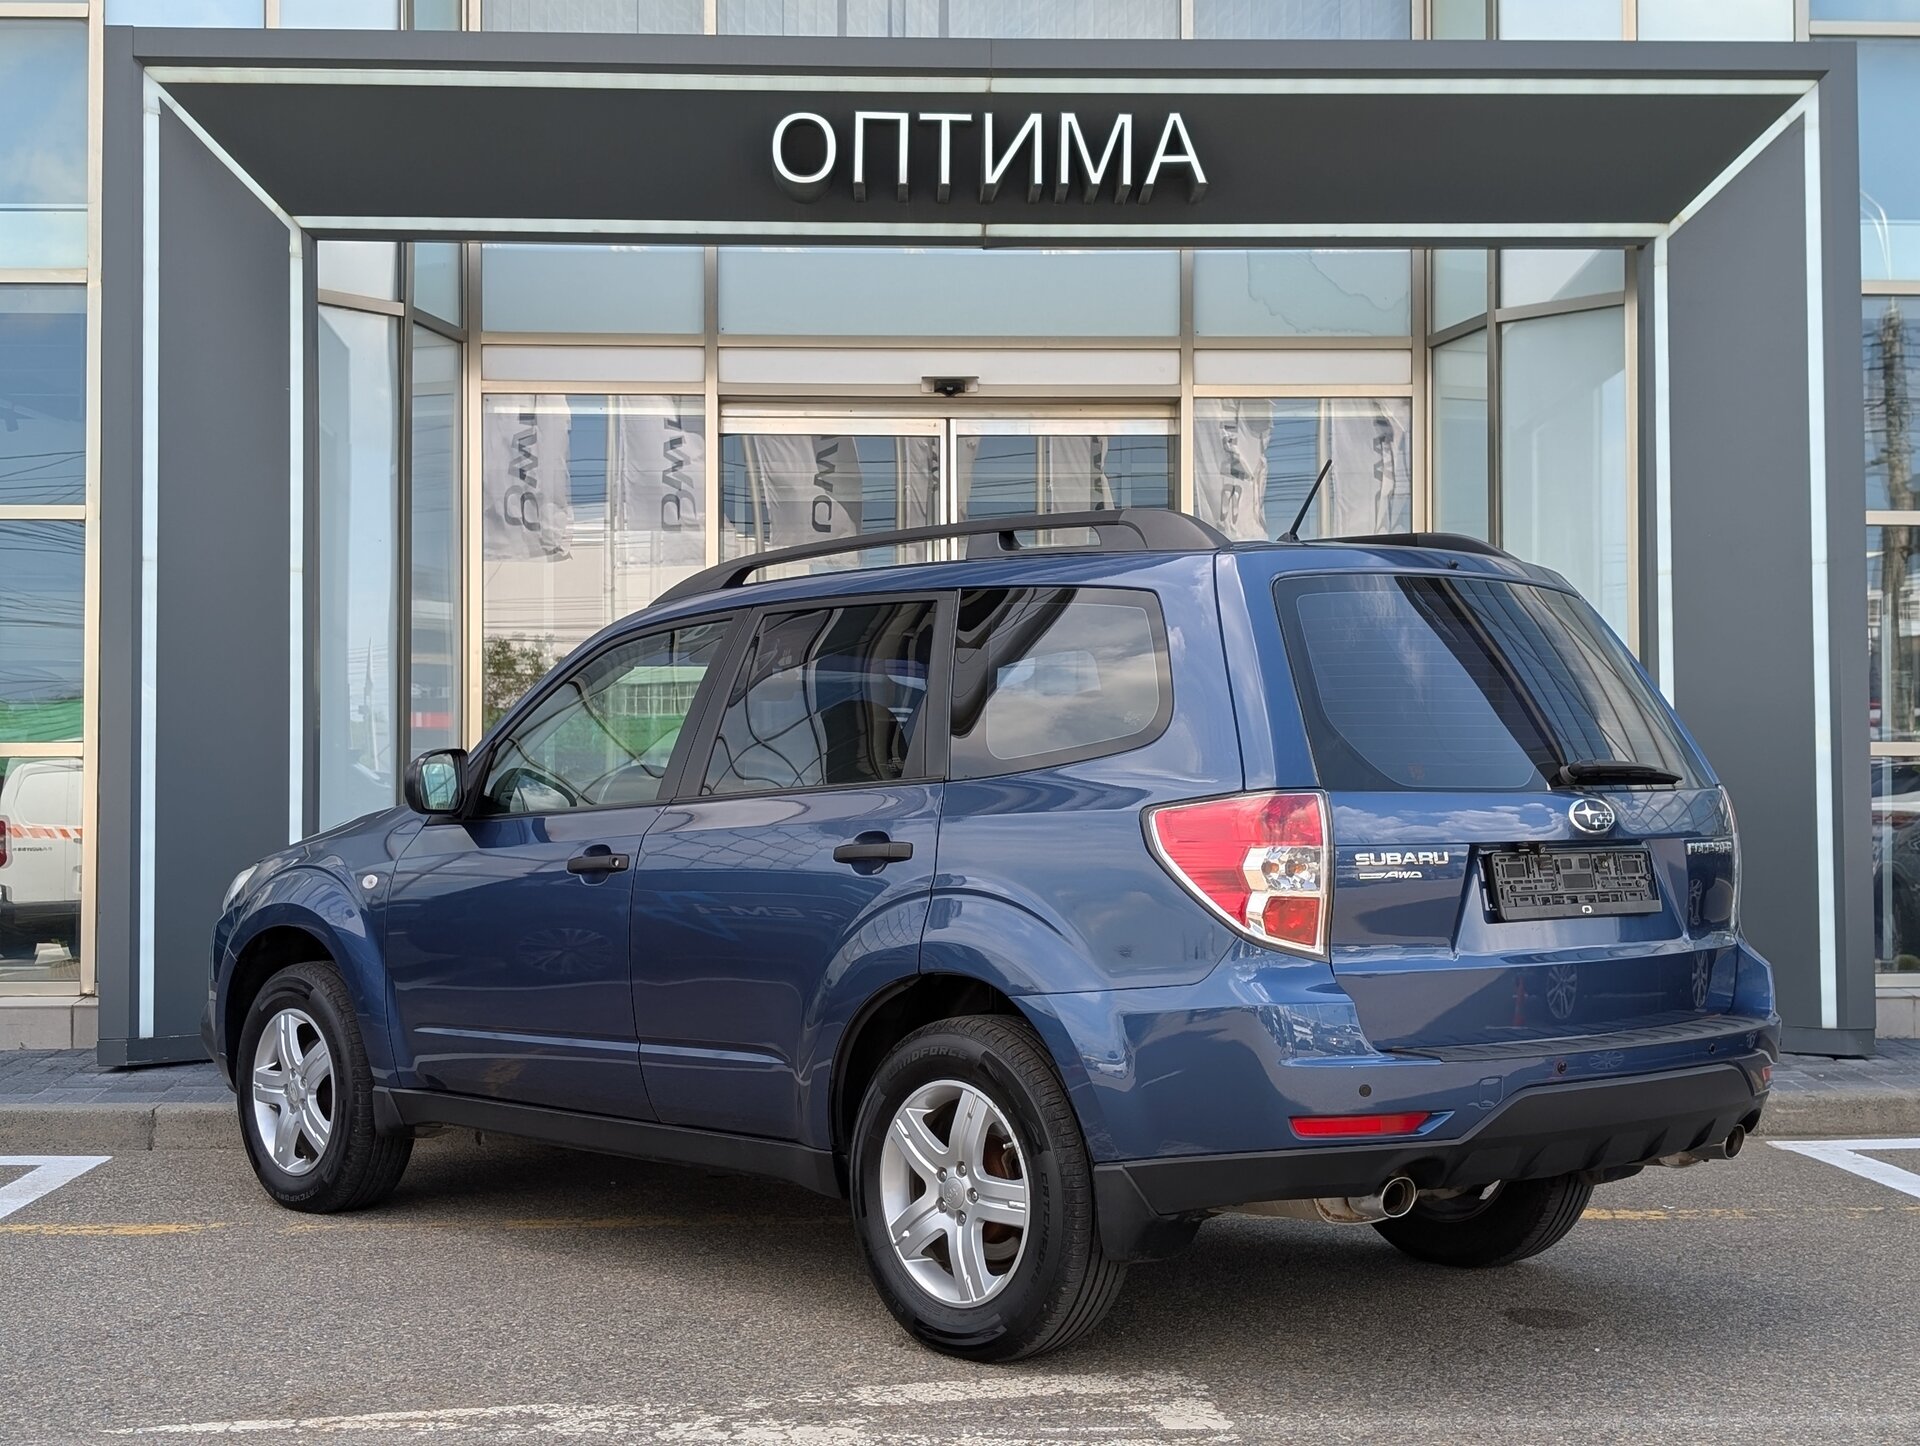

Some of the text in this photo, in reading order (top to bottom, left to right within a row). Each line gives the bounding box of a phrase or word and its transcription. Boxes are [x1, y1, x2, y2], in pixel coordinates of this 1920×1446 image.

[772, 111, 1207, 184] ОПТИМА
[1355, 851, 1449, 866] SUBARU
[1384, 870, 1423, 879] AWD
